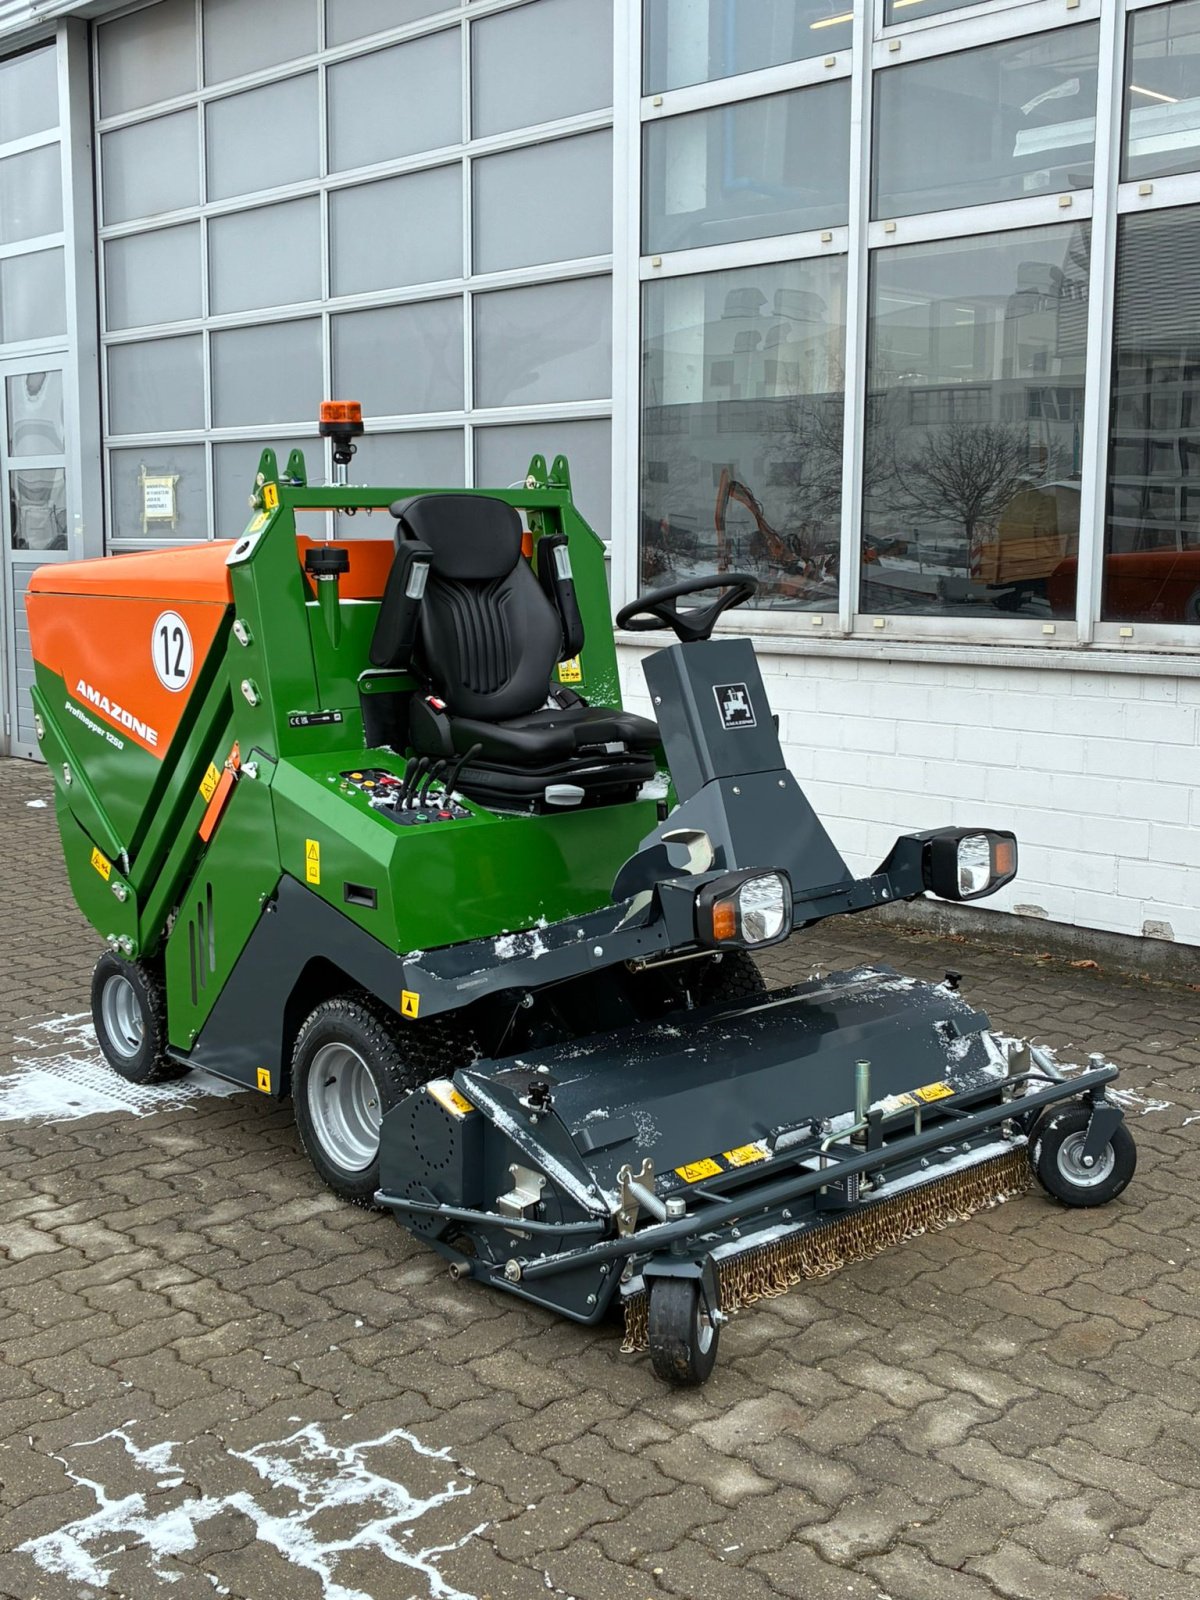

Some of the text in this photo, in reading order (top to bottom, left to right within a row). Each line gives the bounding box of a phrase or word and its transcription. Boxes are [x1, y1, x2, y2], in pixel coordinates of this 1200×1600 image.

[161, 625, 185, 677] 12
[64, 701, 105, 736] Profihopper
[76, 679, 158, 746] AMAZONE
